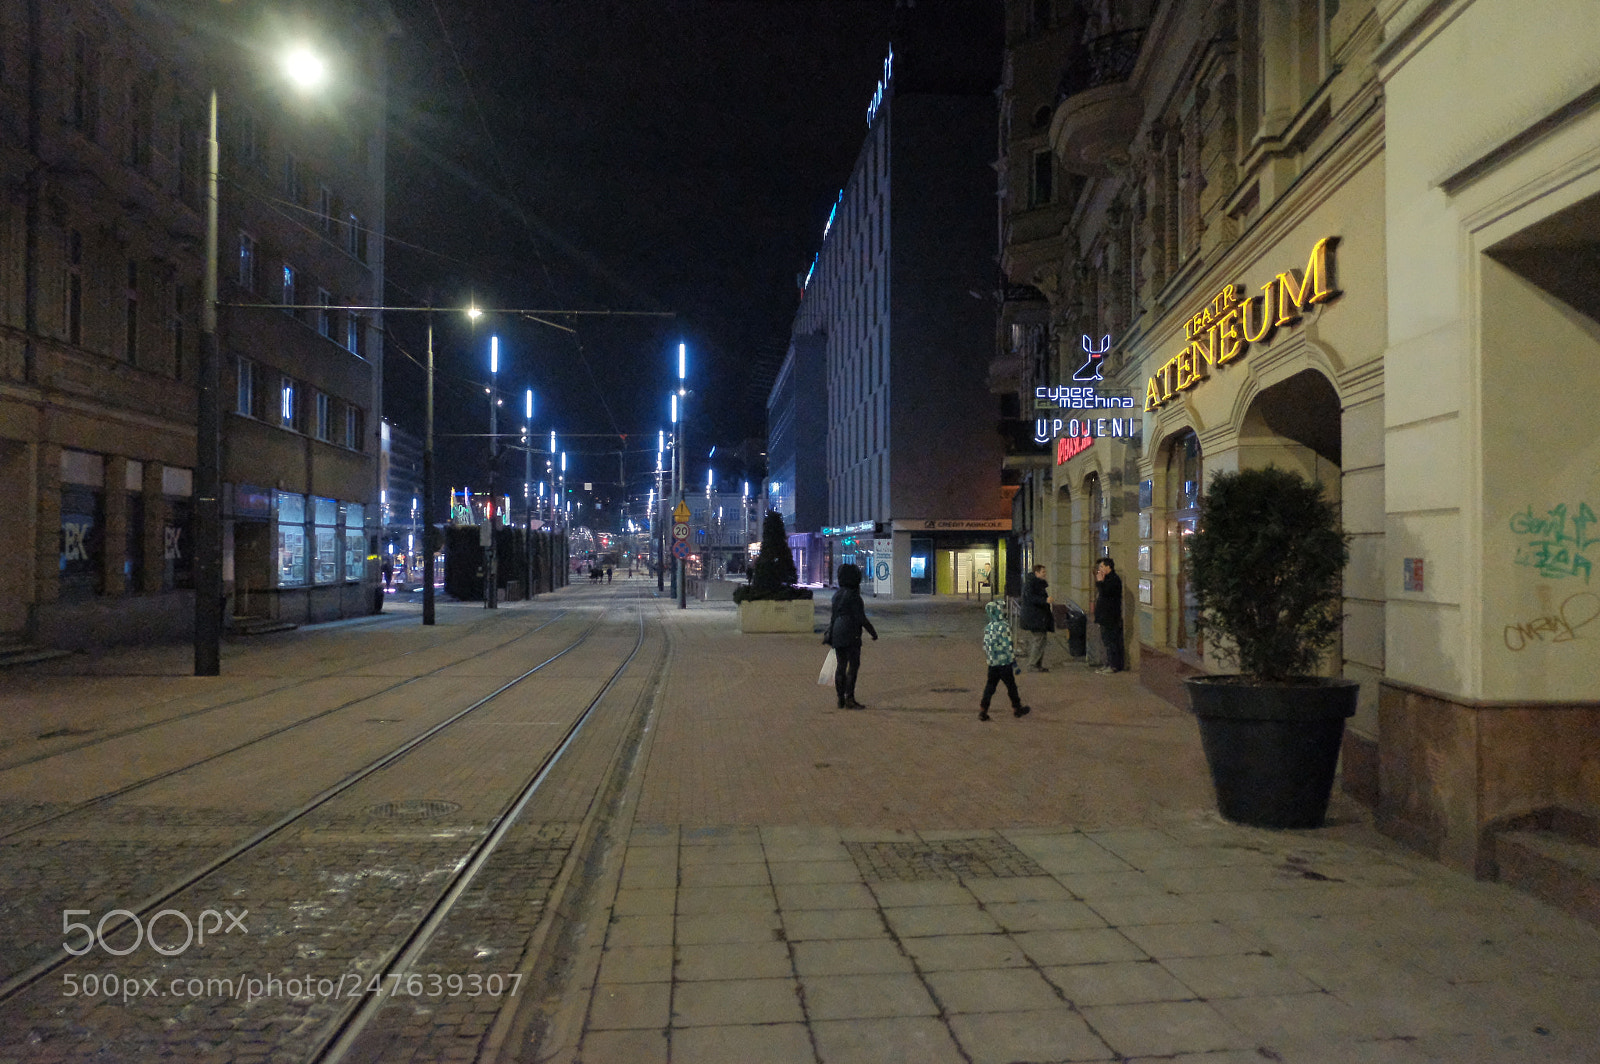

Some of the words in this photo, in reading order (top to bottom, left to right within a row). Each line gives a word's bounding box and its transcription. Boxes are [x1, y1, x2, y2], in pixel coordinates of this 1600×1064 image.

[1183, 284, 1237, 342] TEATR
[1144, 237, 1334, 412] ATENEUM
[1059, 395, 1134, 408] machina
[1036, 417, 1135, 439] UPOJENI
[675, 527, 688, 536] 20
